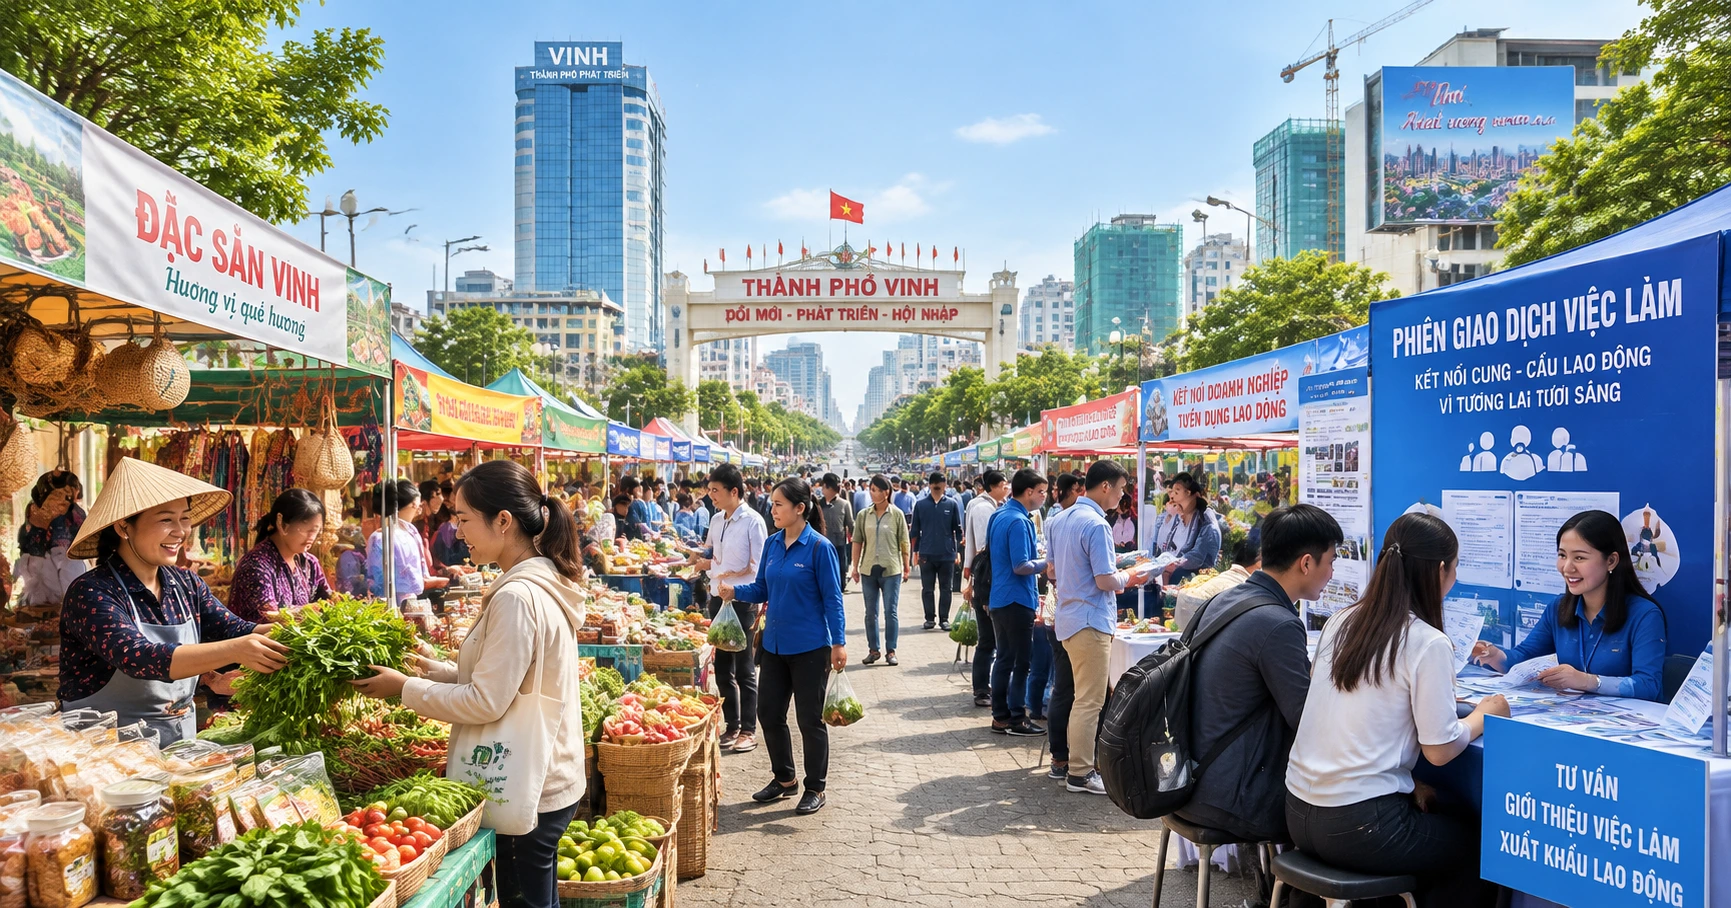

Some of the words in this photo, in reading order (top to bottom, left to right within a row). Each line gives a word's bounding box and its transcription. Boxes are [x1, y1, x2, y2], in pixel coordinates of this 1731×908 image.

[548, 47, 608, 66] VINH
[271, 256, 320, 313] VINH
[742, 272, 821, 297] THÀNH
[884, 278, 939, 297] VINH
[223, 292, 237, 320] vị
[1392, 315, 1447, 358] PHIÊN
[1453, 311, 1499, 350] GIAO
[1506, 301, 1556, 347] DỊCH
[1563, 285, 1617, 338] VIỆC
[1625, 275, 1682, 324] LÀM
[1472, 363, 1511, 385] CUNG
[1563, 353, 1596, 375] LAO
[1601, 344, 1652, 374] ĐỘNG
[1233, 403, 1252, 423] LAO
[1555, 763, 1578, 791] TƯ
[1582, 764, 1619, 801] VẤN
[1541, 803, 1588, 838] THIỆU
[1593, 814, 1632, 851] VIỆC
[1593, 857, 1626, 889] LAO
[1632, 868, 1684, 908] ĐỘNG
